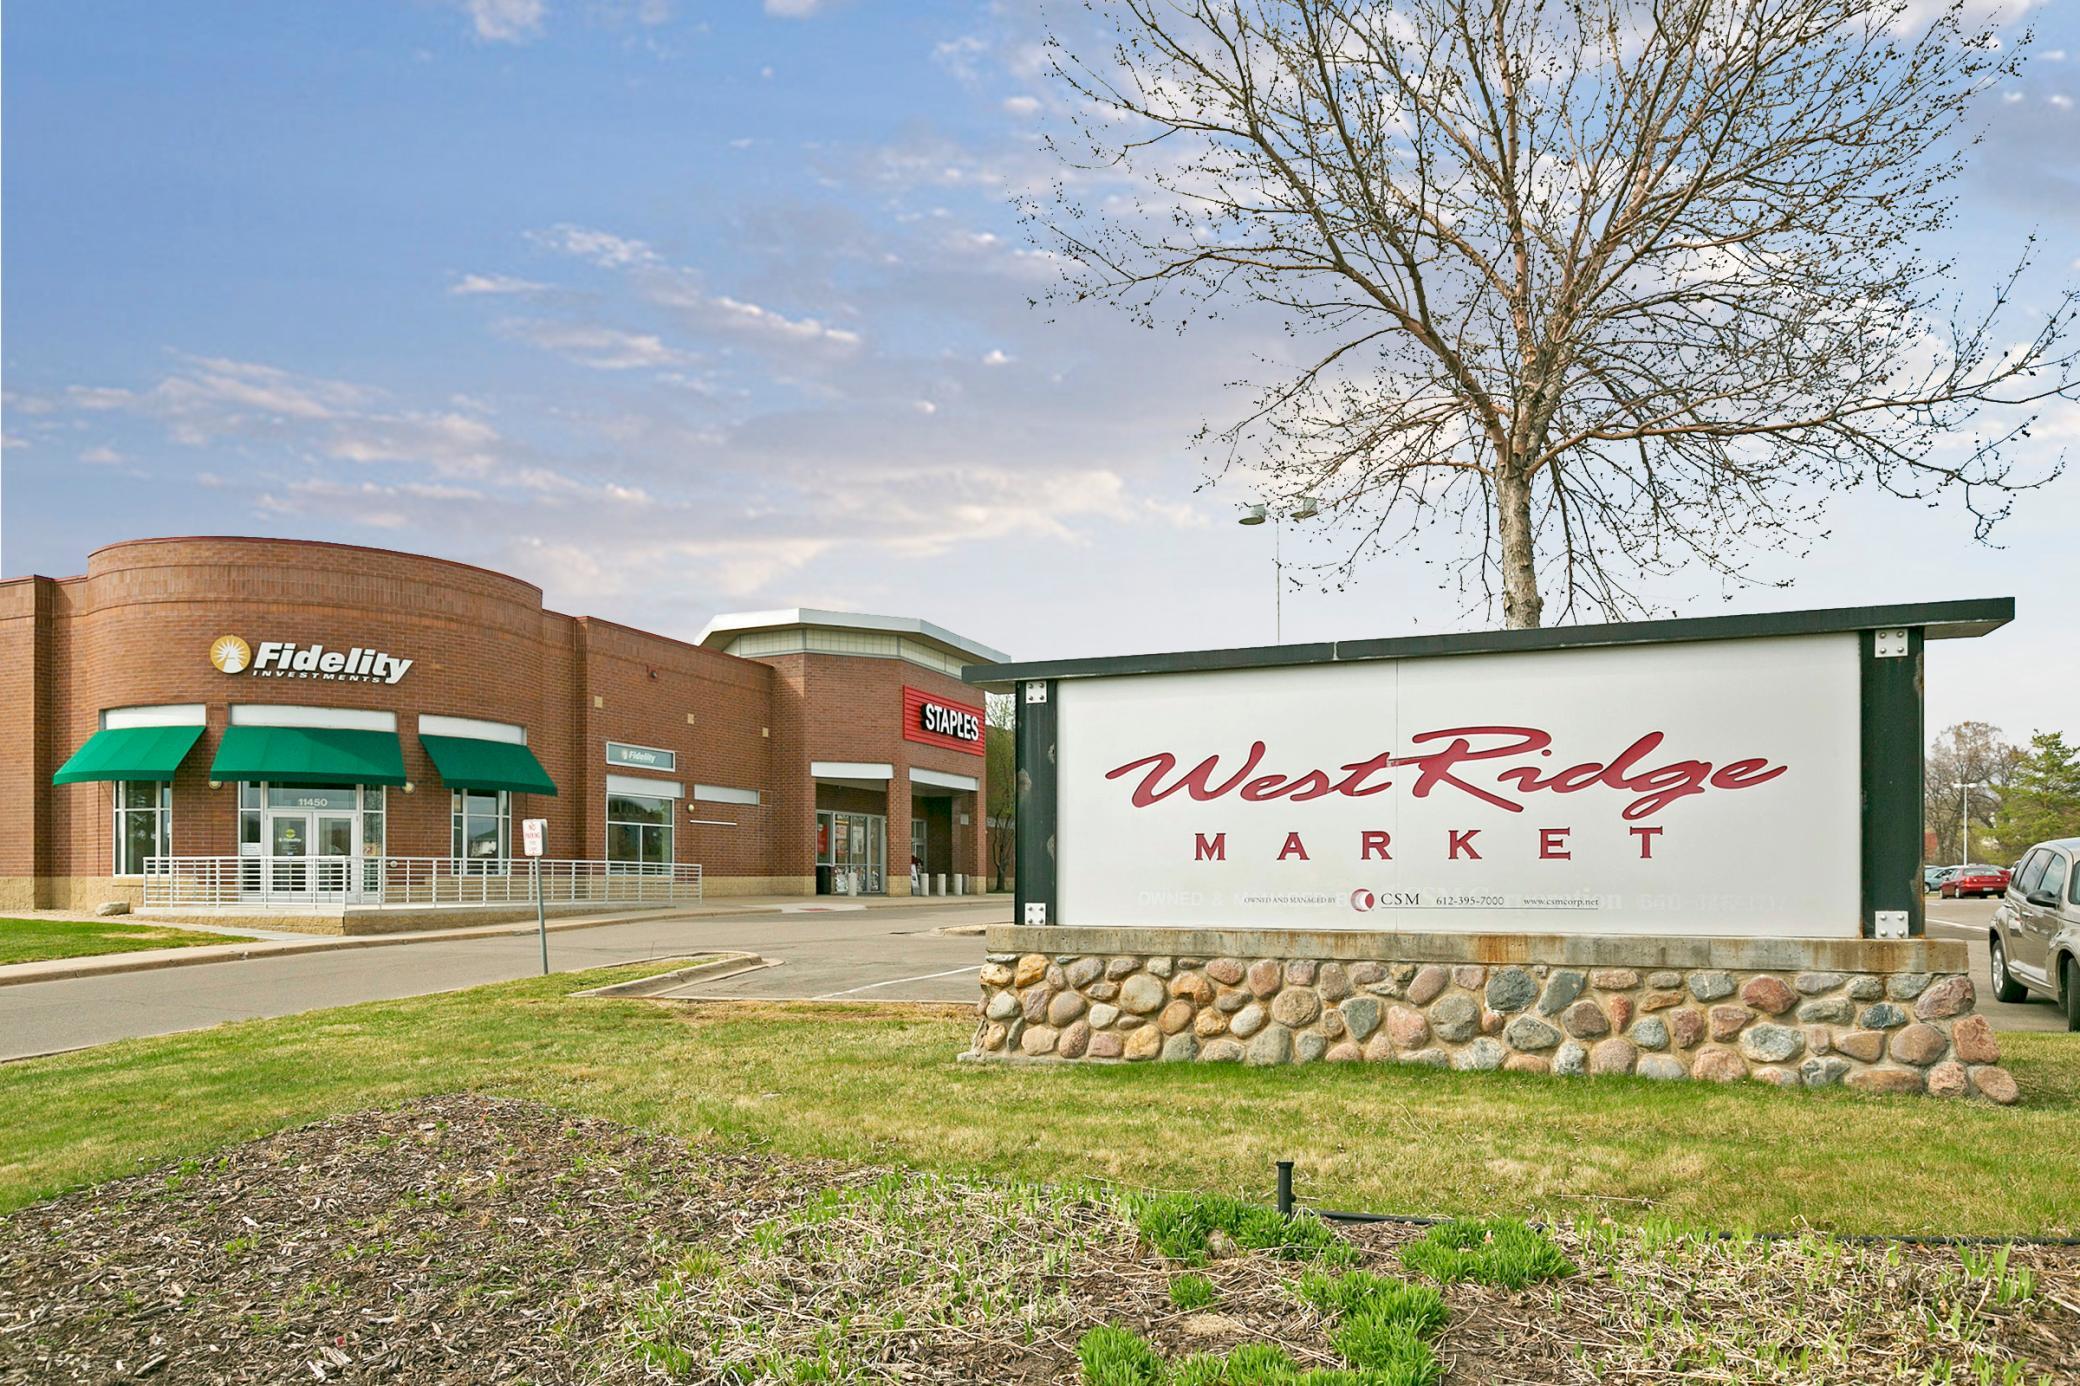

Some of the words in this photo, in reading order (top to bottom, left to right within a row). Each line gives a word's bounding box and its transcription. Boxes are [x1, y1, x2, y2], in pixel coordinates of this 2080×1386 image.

[253, 641, 414, 685] Fidelity
[252, 669, 382, 684] INVESTMENTS
[925, 702, 979, 741] STAPLES
[628, 750, 657, 764] Fidelity
[1106, 740, 1393, 808] West
[1394, 725, 1788, 821] Ridge
[298, 798, 328, 807] 11450
[1194, 826, 1664, 861] MARKET
[1243, 896, 1272, 904] OWNED
[1273, 896, 1289, 904] AND
[1289, 896, 1327, 904] MANAGED
[1327, 896, 1336, 904] BY
[1380, 893, 1420, 905] CSM
[1436, 896, 1505, 906] 612-395-7000
[1523, 897, 1599, 907] www.csmcorp.net
